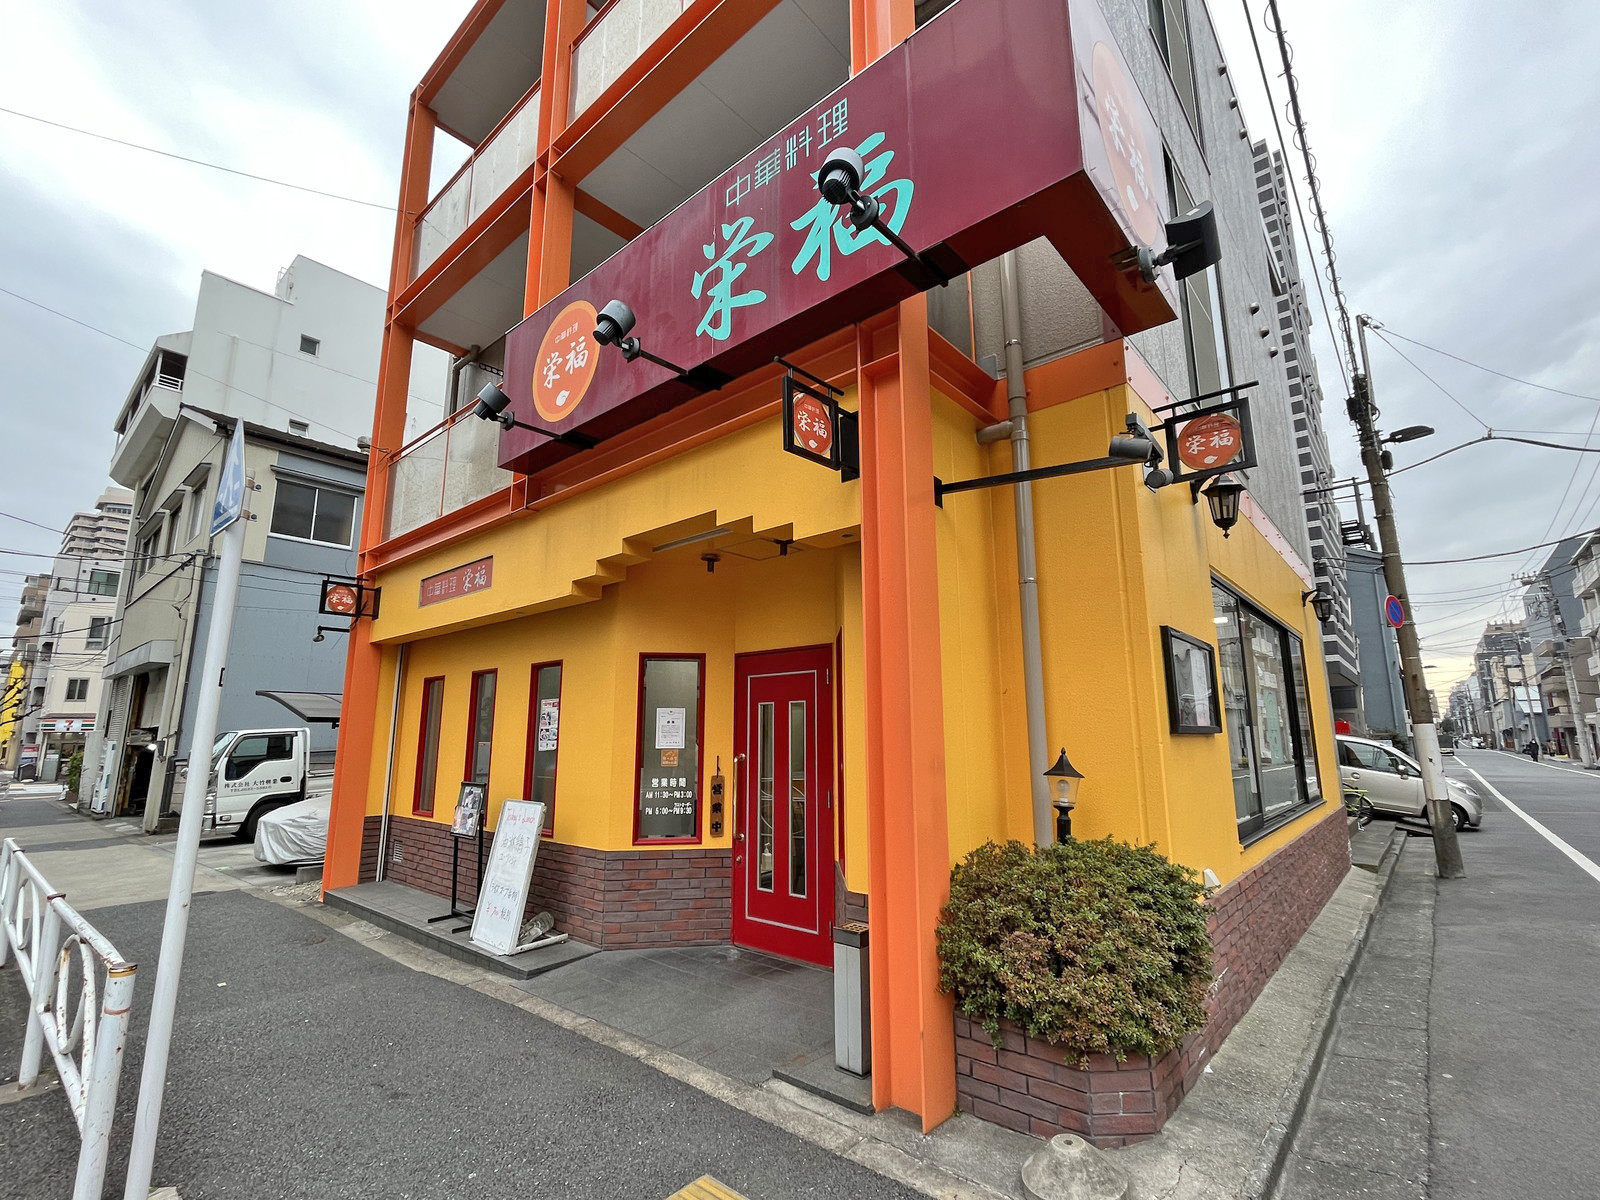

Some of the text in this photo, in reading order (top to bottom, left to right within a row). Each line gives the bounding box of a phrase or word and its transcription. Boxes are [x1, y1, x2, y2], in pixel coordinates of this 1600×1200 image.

[726, 97, 848, 207] 中華料理
[543, 336, 589, 389] 栄福
[797, 410, 828, 439] 栄福
[1185, 429, 1234, 455] 栄福
[462, 565, 487, 592] 栄福
[651, 777, 687, 788] 営業時間
